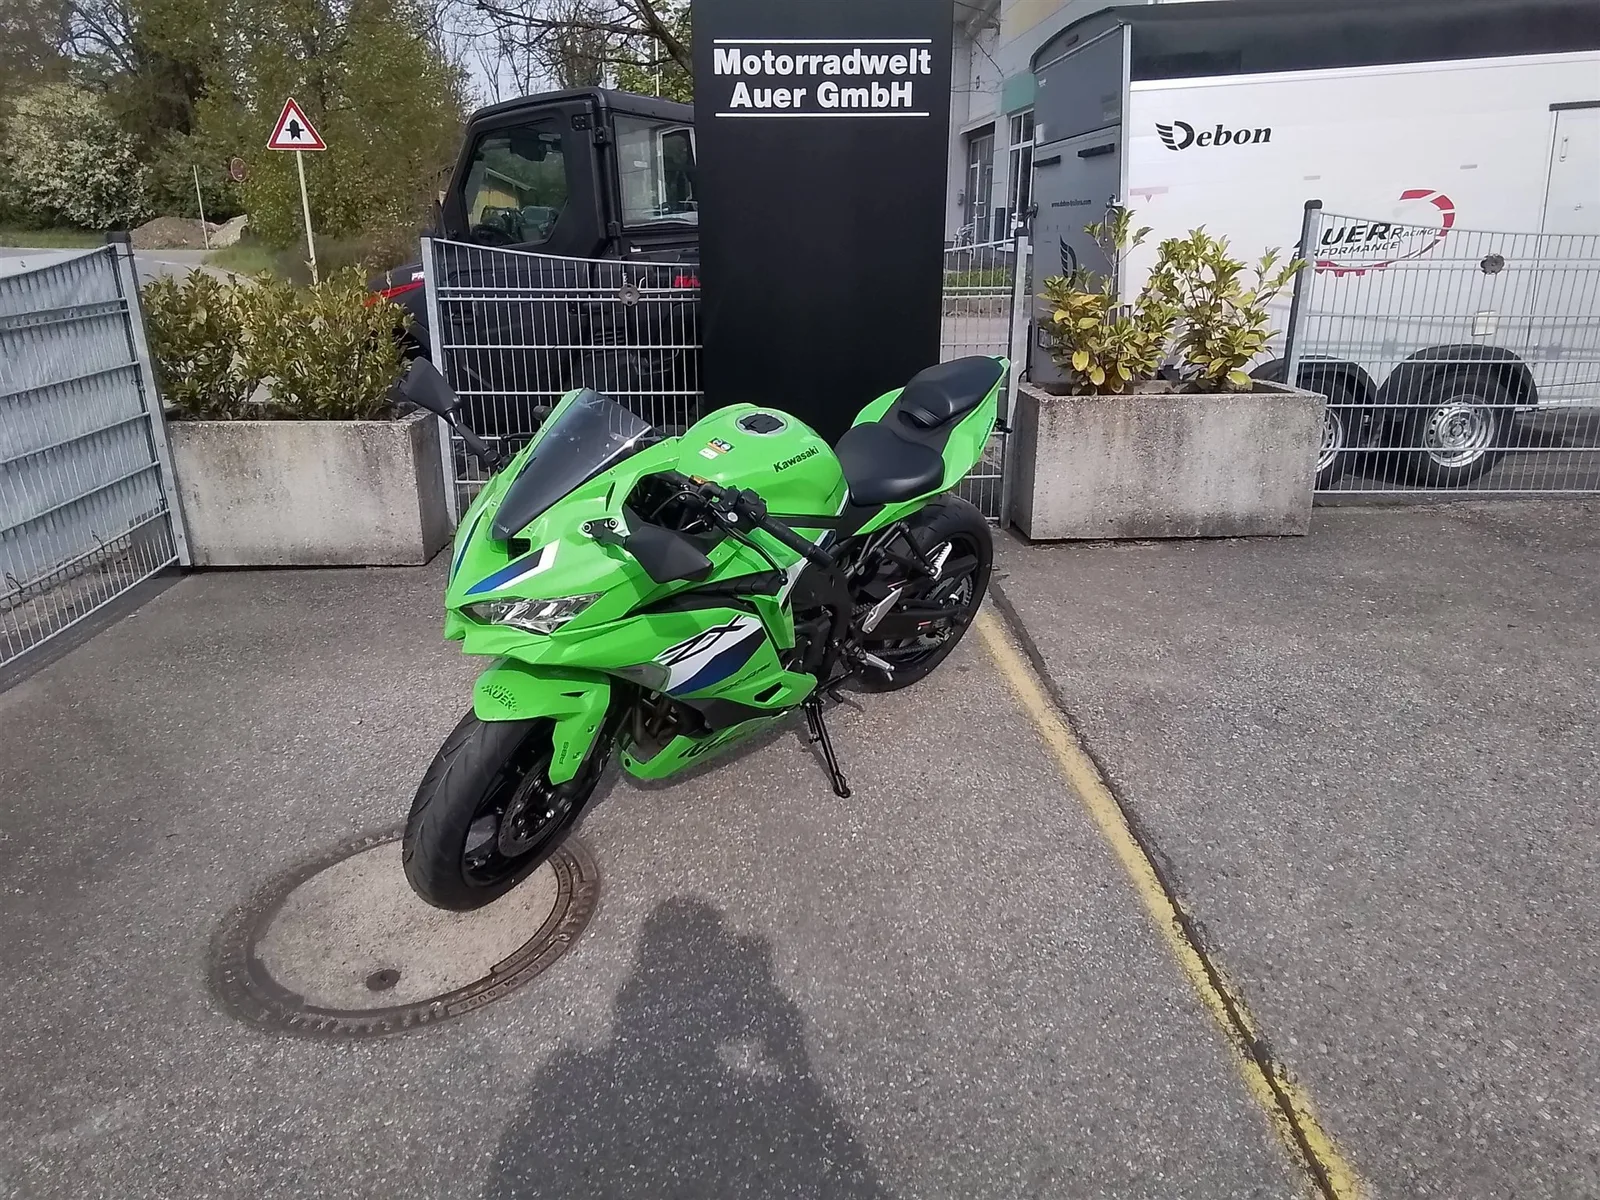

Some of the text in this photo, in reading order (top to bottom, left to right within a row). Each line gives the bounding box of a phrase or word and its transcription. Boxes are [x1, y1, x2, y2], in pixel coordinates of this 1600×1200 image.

[713, 48, 931, 75] Motorradwelt
[729, 81, 913, 108] Auer GmbH
[1155, 120, 1272, 151] Debon
[1292, 223, 1392, 248] UER
[773, 445, 820, 473] Kawasaki
[482, 687, 514, 711] AUER
